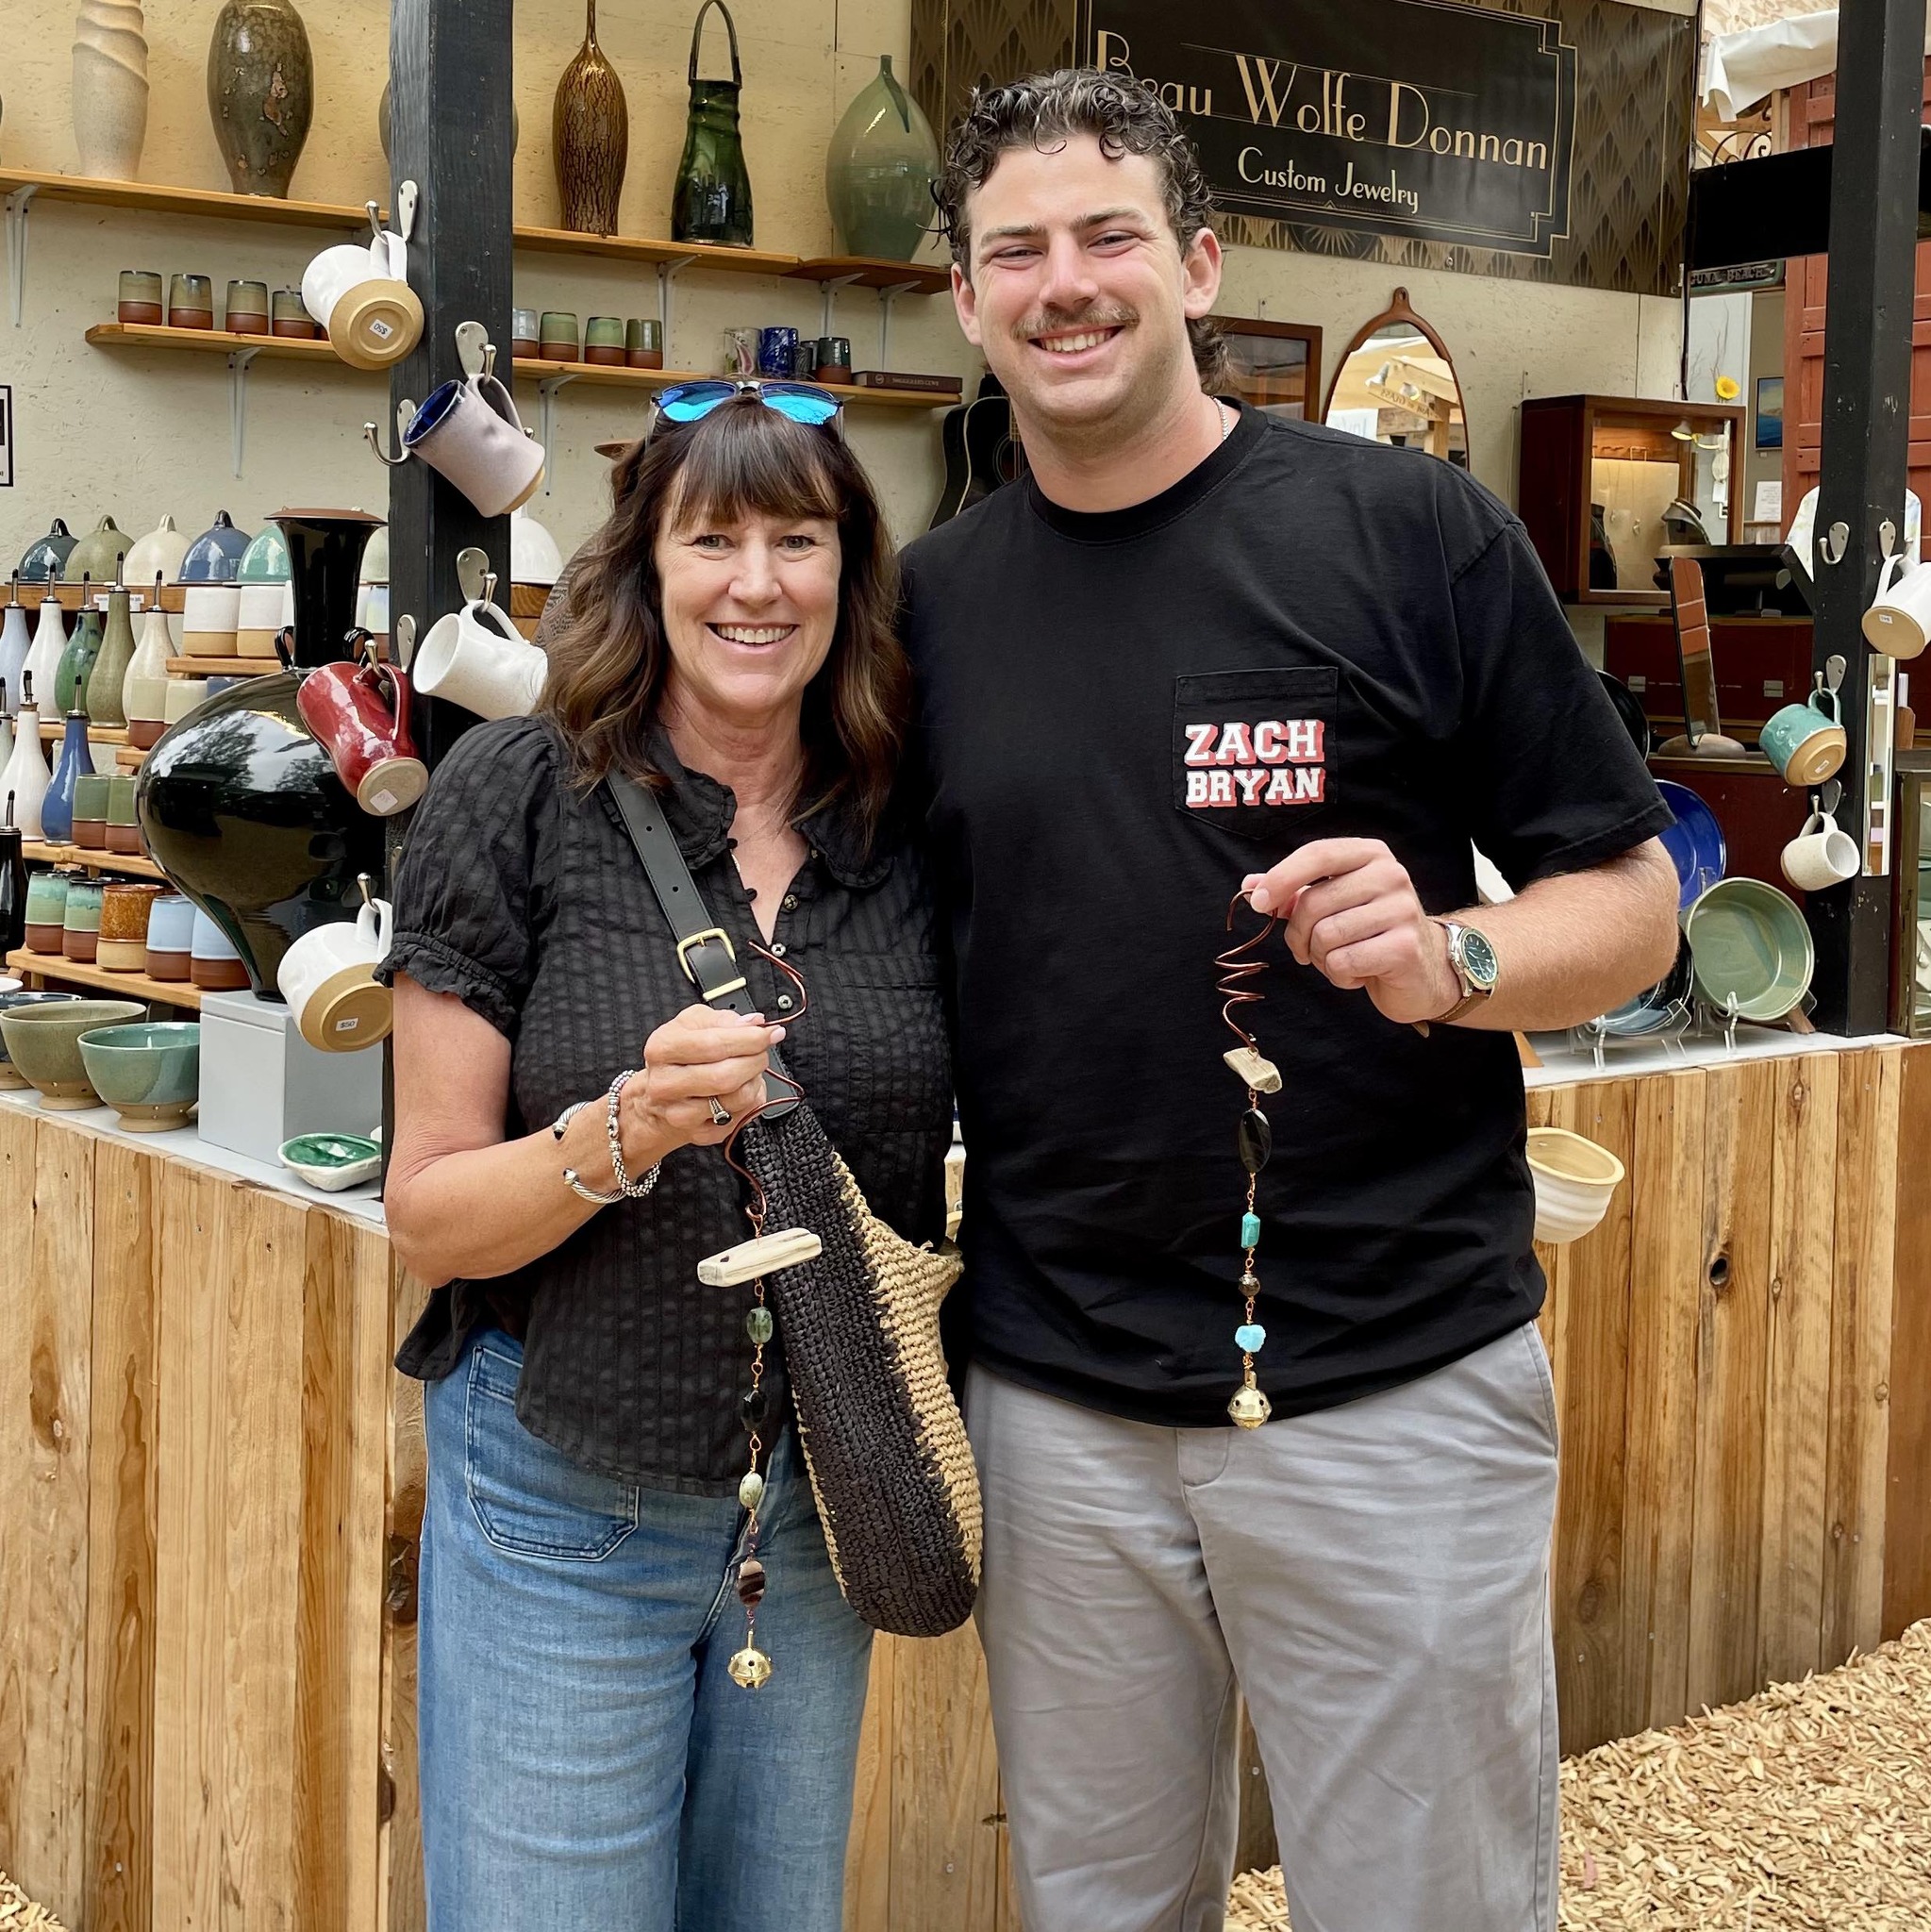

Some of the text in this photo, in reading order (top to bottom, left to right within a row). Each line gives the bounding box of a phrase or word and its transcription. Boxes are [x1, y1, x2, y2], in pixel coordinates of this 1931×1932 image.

[1097, 29, 1547, 170] Beau Wolfe Donnan
[1238, 146, 1419, 214] Custom Jewelry
[374, 323, 388, 334] $50
[1184, 719, 1325, 767] ZACH
[1185, 766, 1326, 808] BRYAN
